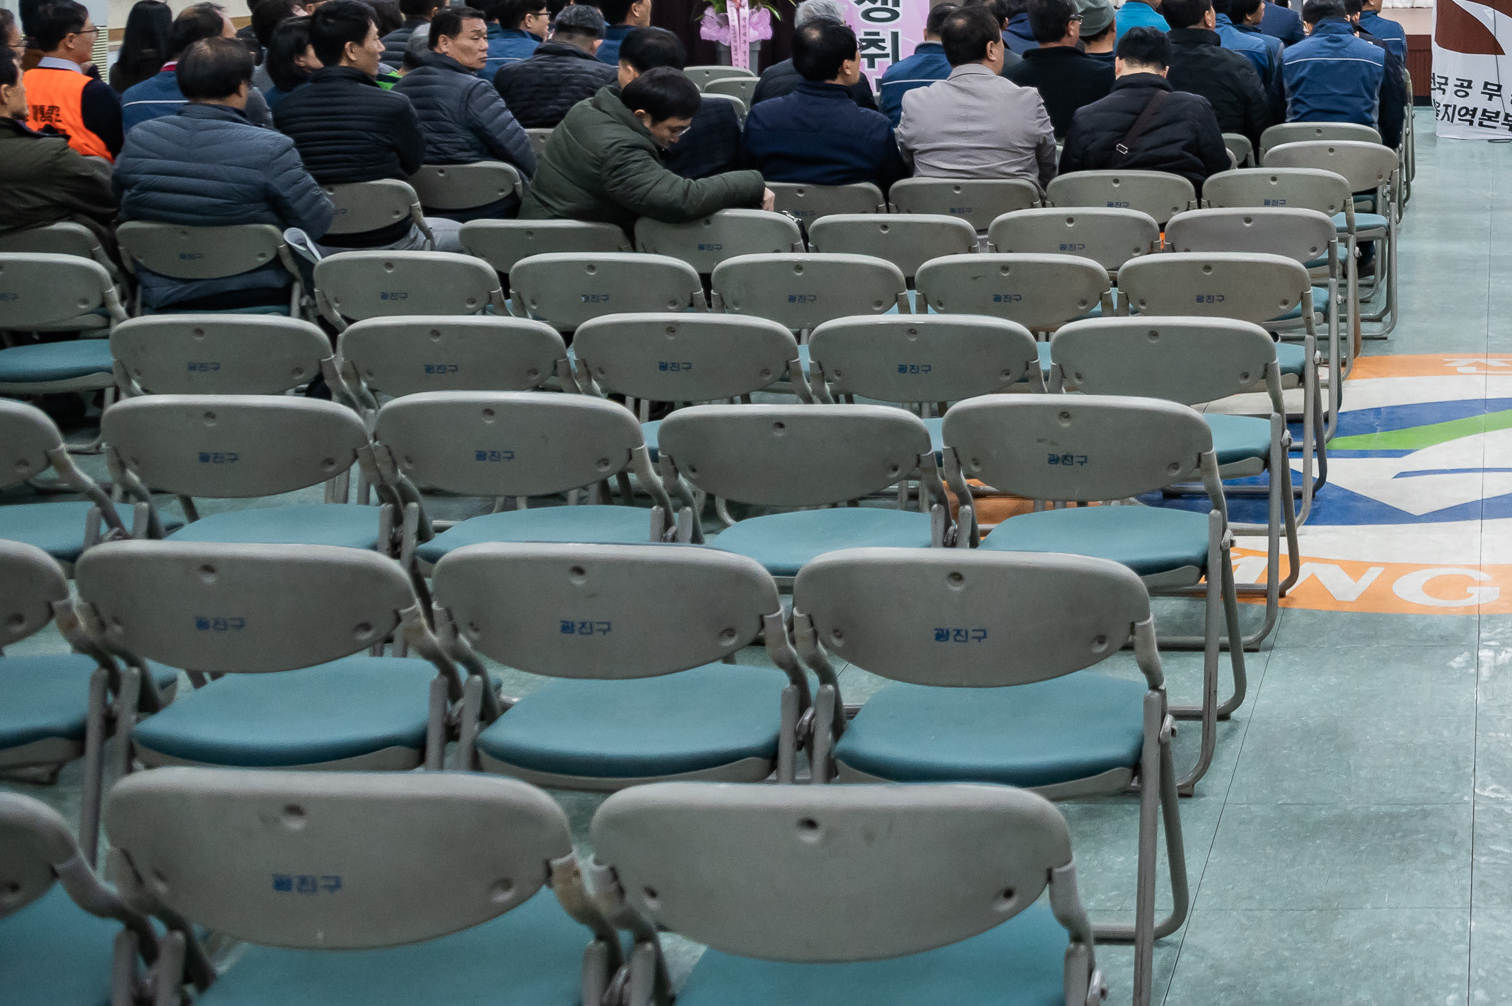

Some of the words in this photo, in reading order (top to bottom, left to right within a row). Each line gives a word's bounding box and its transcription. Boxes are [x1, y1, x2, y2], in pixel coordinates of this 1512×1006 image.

[897, 364, 932, 375] 광진구
[1047, 453, 1088, 467] 광진구
[560, 620, 611, 636] 광진구
[934, 627, 987, 643] 광진구
